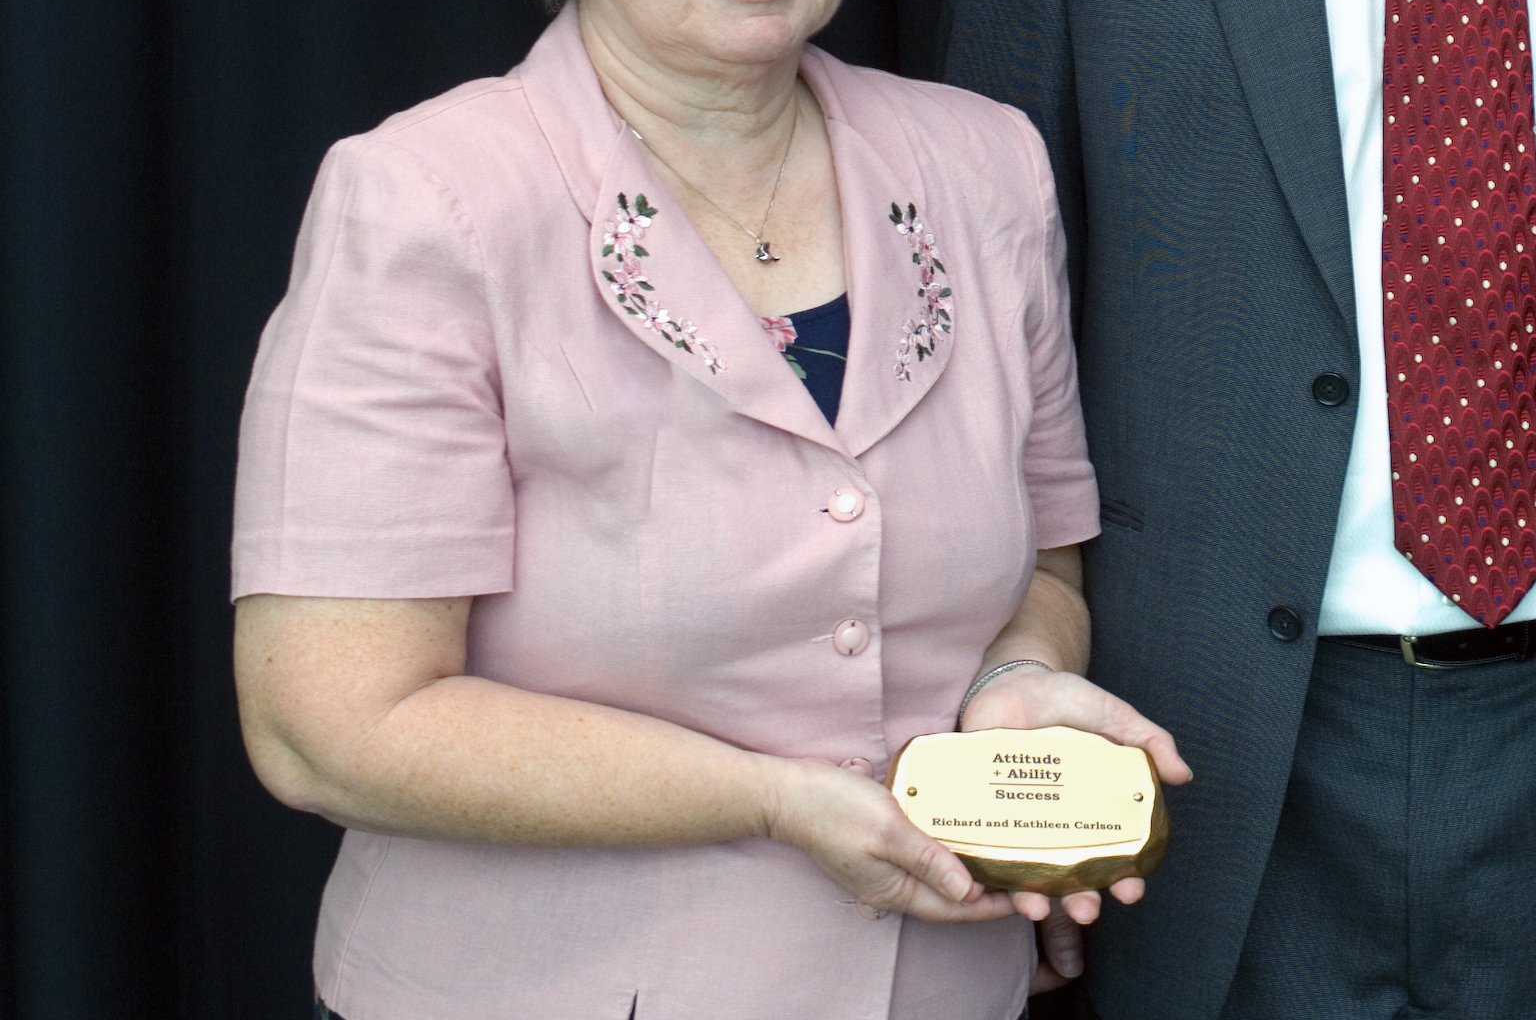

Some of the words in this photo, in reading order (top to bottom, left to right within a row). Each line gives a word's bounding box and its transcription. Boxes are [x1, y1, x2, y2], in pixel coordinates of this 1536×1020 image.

[992, 753, 1061, 765] Attitude
[1007, 768, 1062, 782] Ability
[995, 789, 1060, 801] Success
[932, 817, 982, 827] Richard
[985, 819, 1009, 828] and
[1013, 819, 1070, 829] Kathleen
[1074, 821, 1122, 830] Carlson
